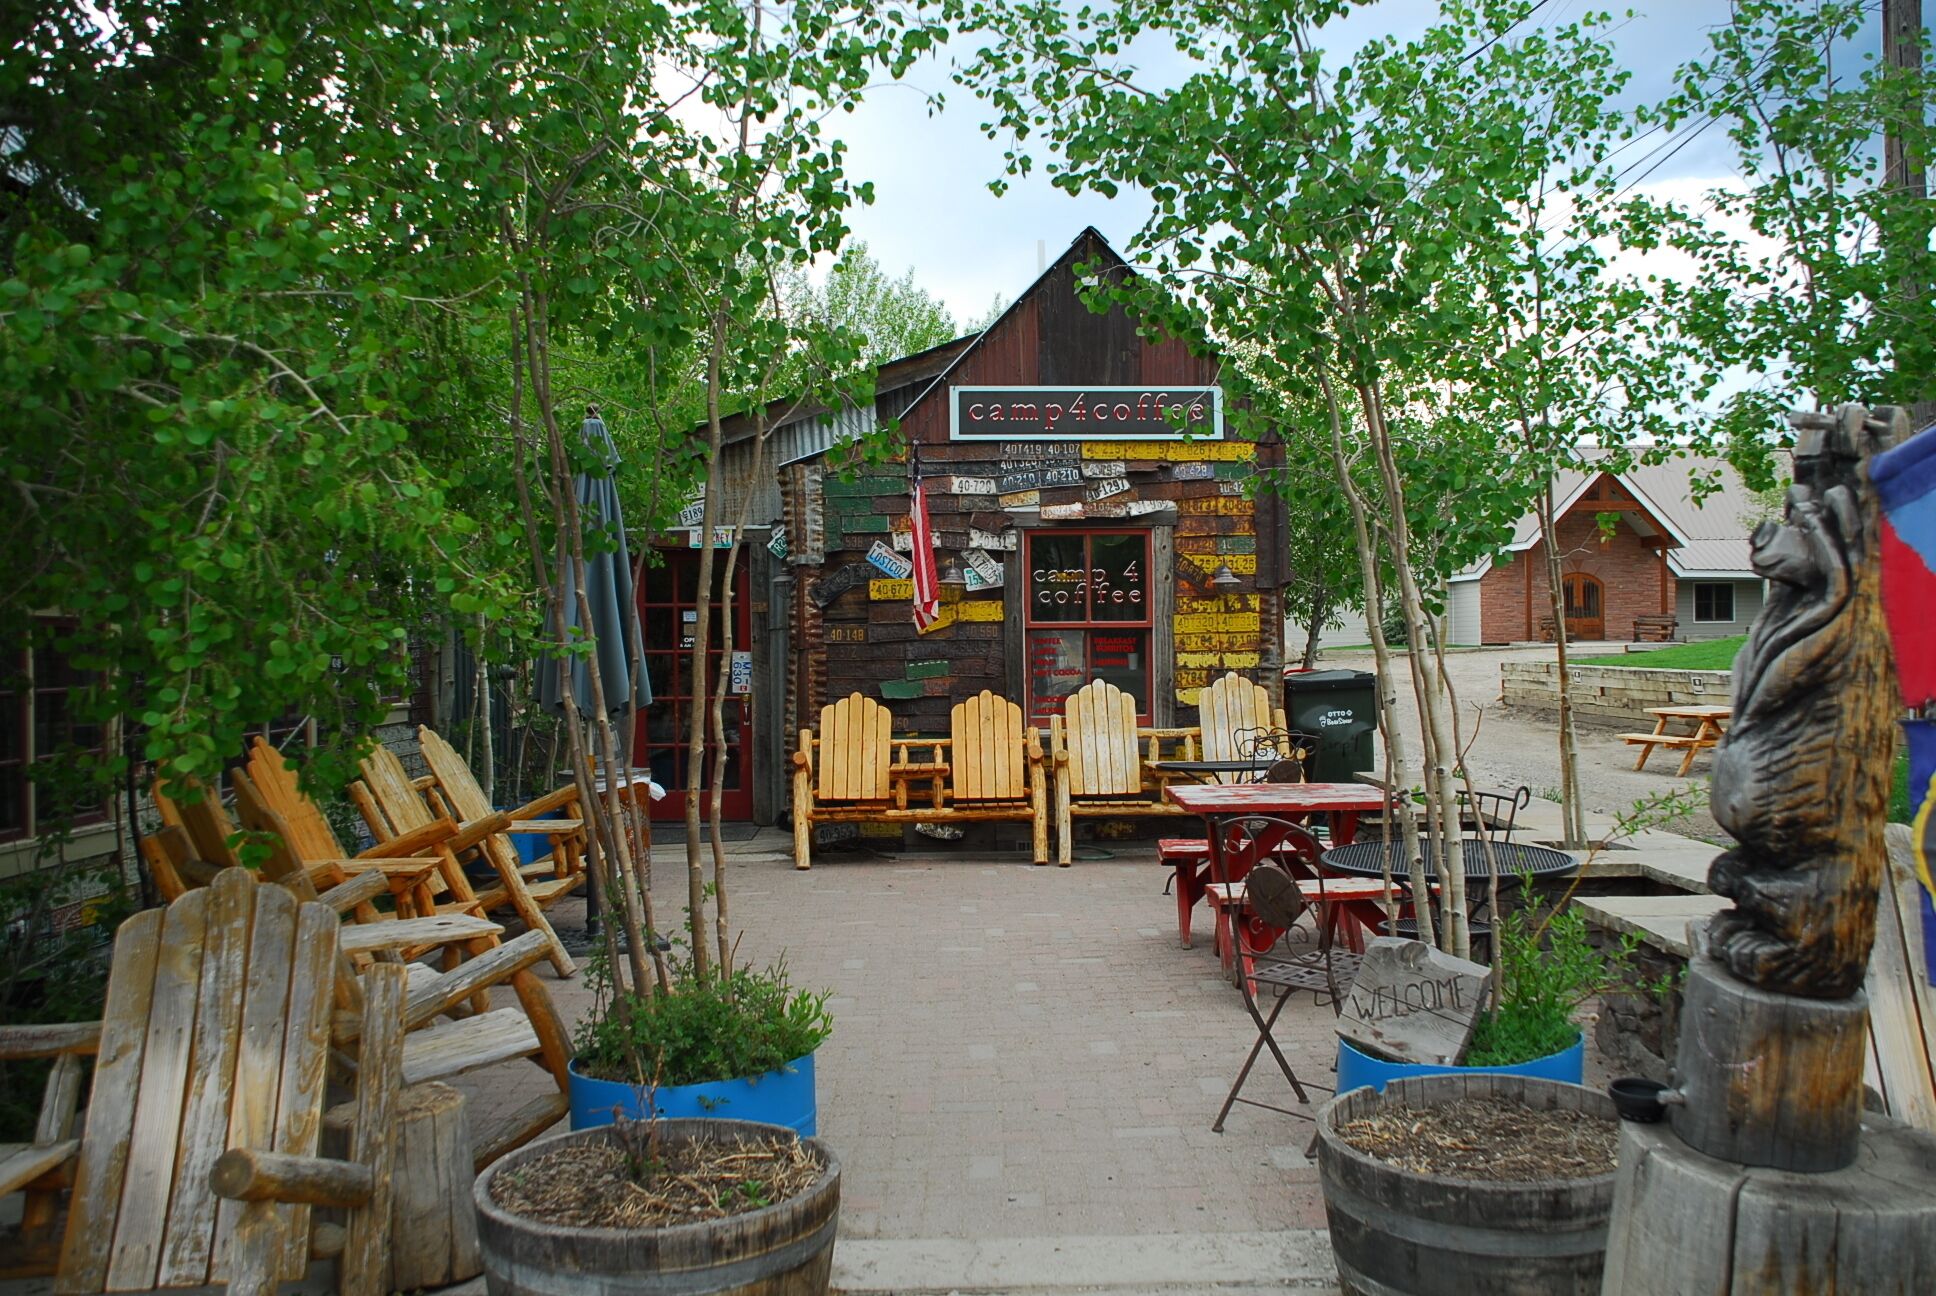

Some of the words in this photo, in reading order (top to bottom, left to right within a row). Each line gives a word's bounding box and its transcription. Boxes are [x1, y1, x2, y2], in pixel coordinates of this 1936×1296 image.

[968, 393, 1204, 430] camp4coffee
[1046, 469, 1079, 482] 40-210
[1033, 569, 1106, 590] camp
[1123, 560, 1139, 582] 4
[1038, 583, 1142, 604] coffee
[830, 628, 863, 641] 40-148
[1351, 973, 1472, 1020] WELCOME
